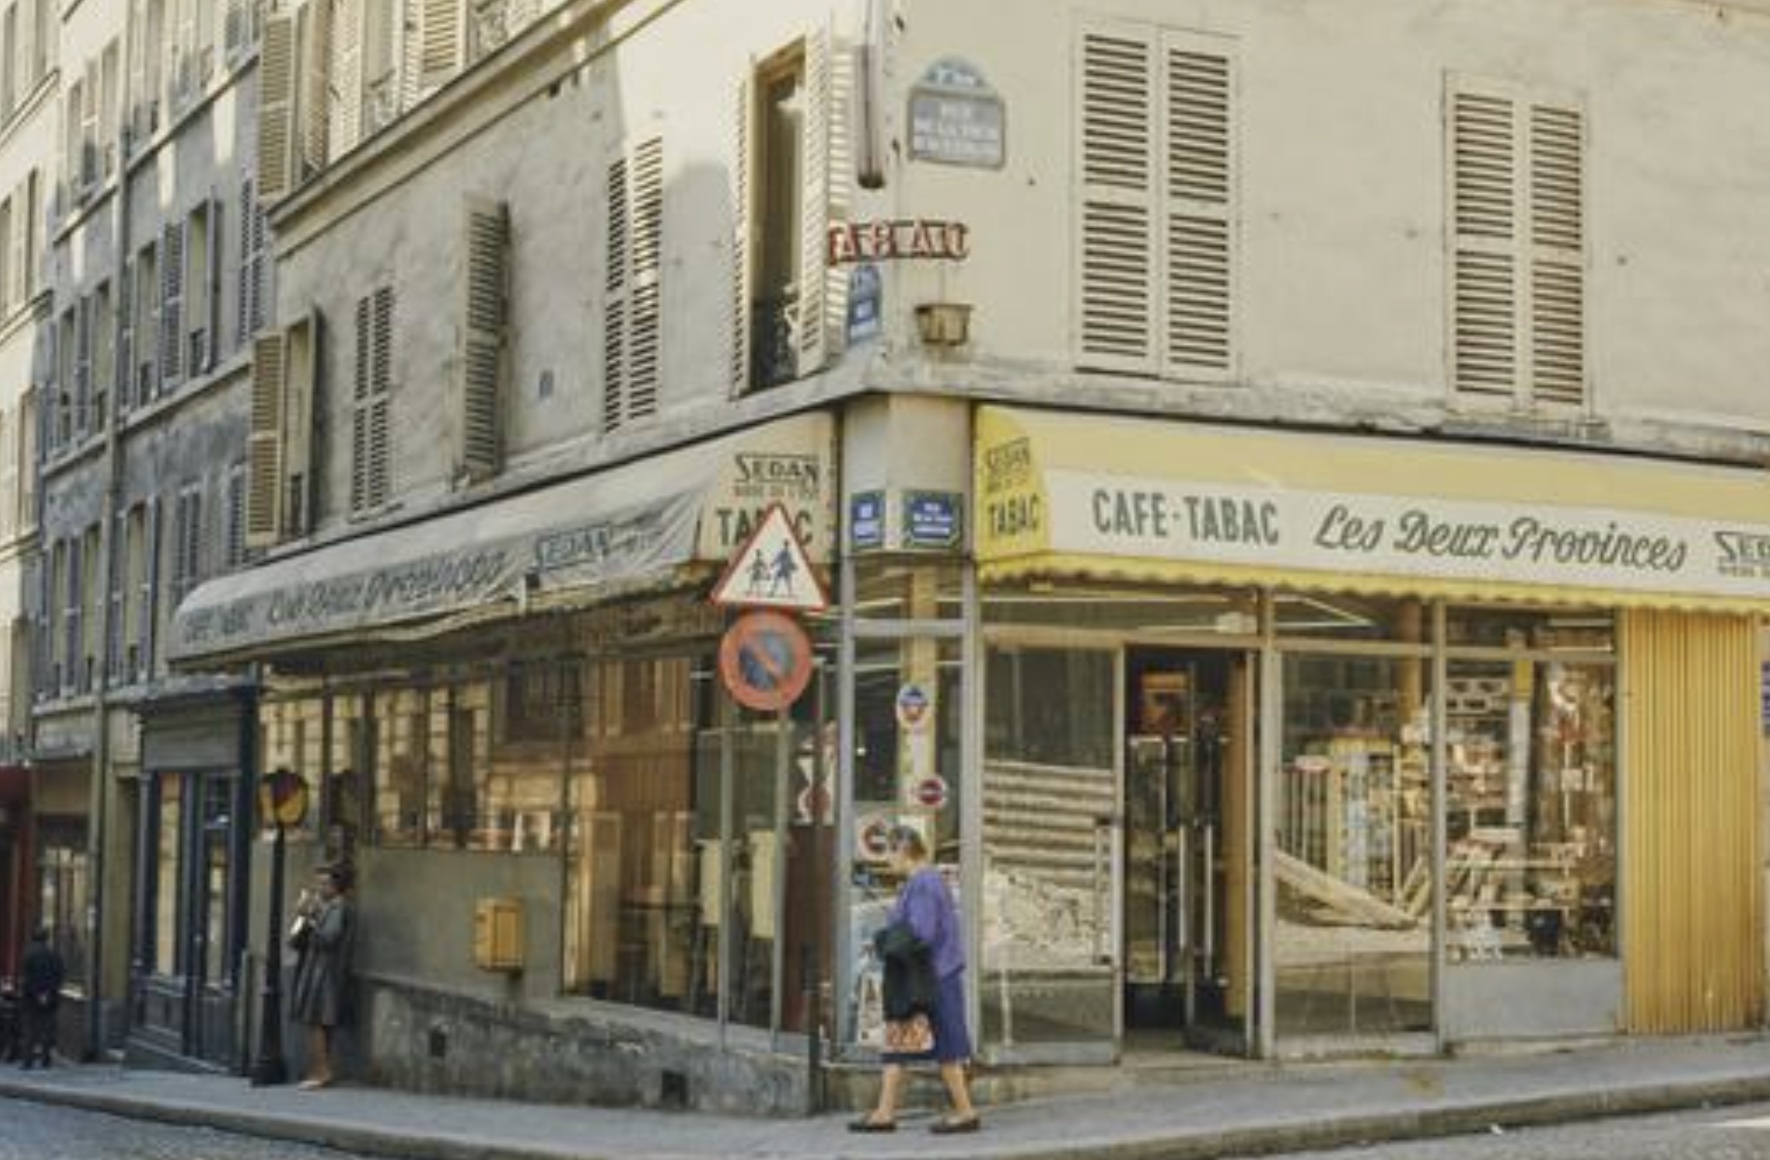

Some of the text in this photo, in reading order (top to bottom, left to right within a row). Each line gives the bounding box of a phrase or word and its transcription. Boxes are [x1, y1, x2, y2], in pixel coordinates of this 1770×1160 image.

[734, 453, 819, 485] SEDAN
[716, 507, 814, 547] TAC
[986, 493, 1040, 539] TABAC
[1314, 503, 1385, 552] Les
[1394, 509, 1500, 557] Deux
[1502, 515, 1687, 572] Provinces
